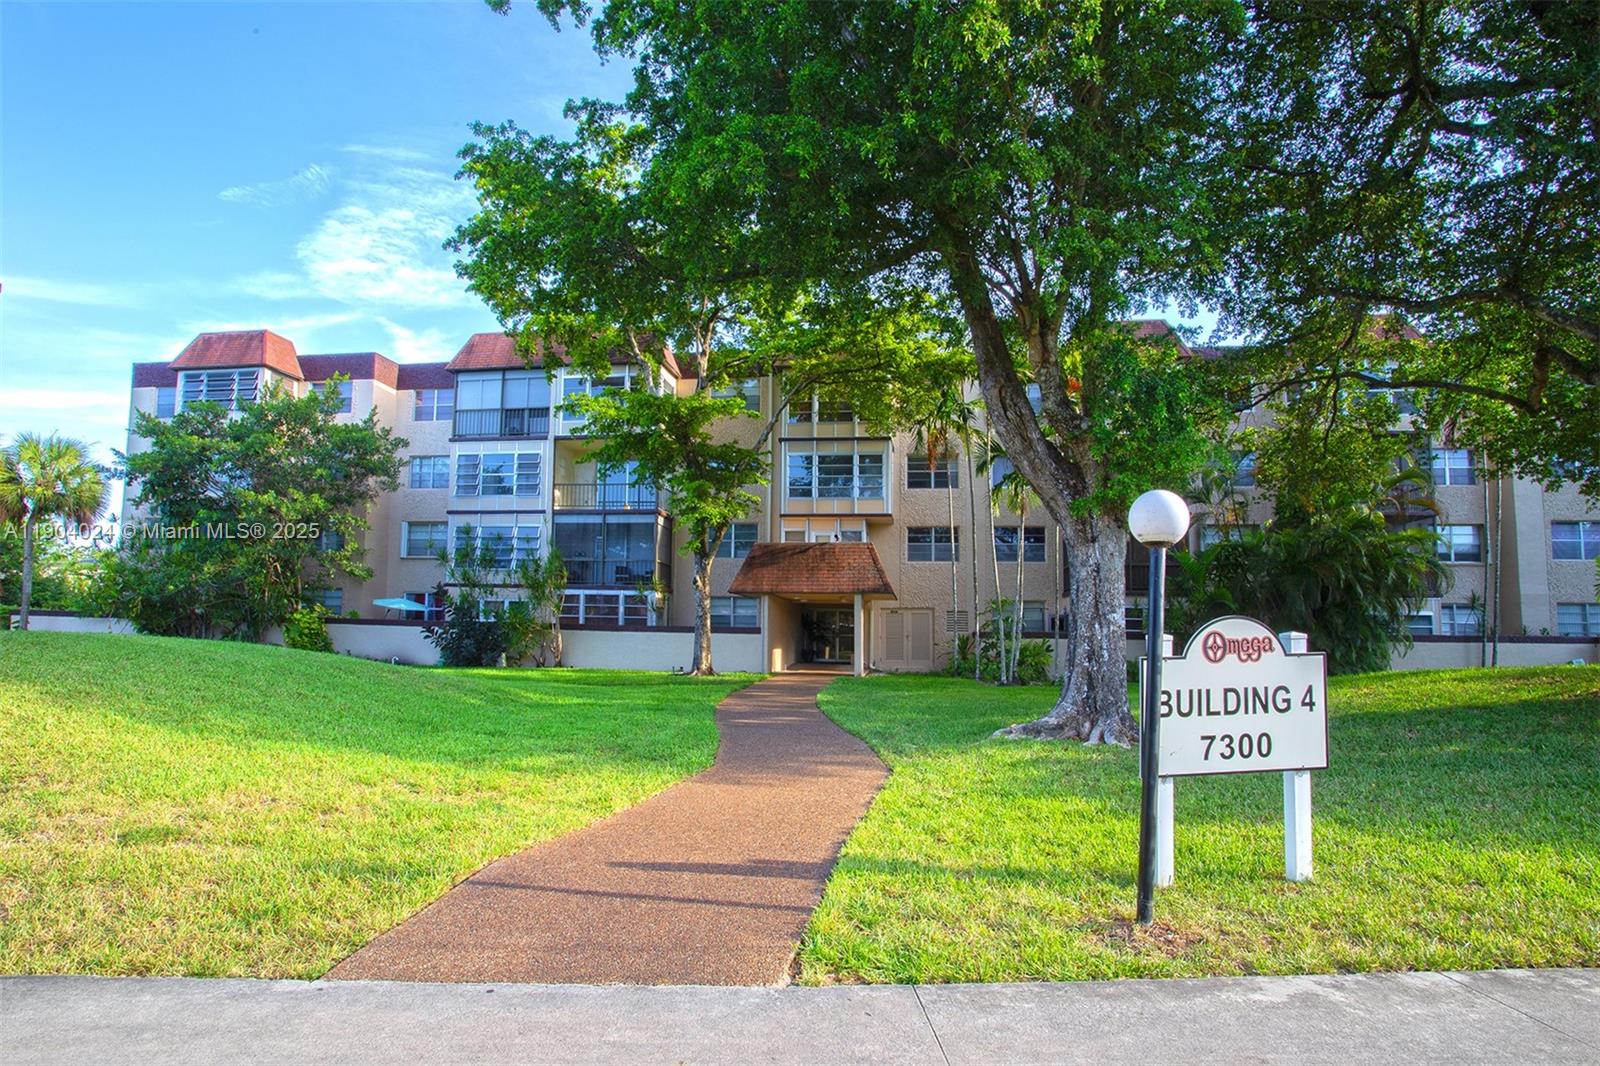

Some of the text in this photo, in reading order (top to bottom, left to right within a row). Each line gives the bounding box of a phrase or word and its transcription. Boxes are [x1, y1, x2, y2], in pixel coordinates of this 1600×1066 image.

[1202, 630, 1275, 664] Omega
[1159, 684, 1316, 718] BUILDING 4
[1200, 732, 1272, 761] 7300
